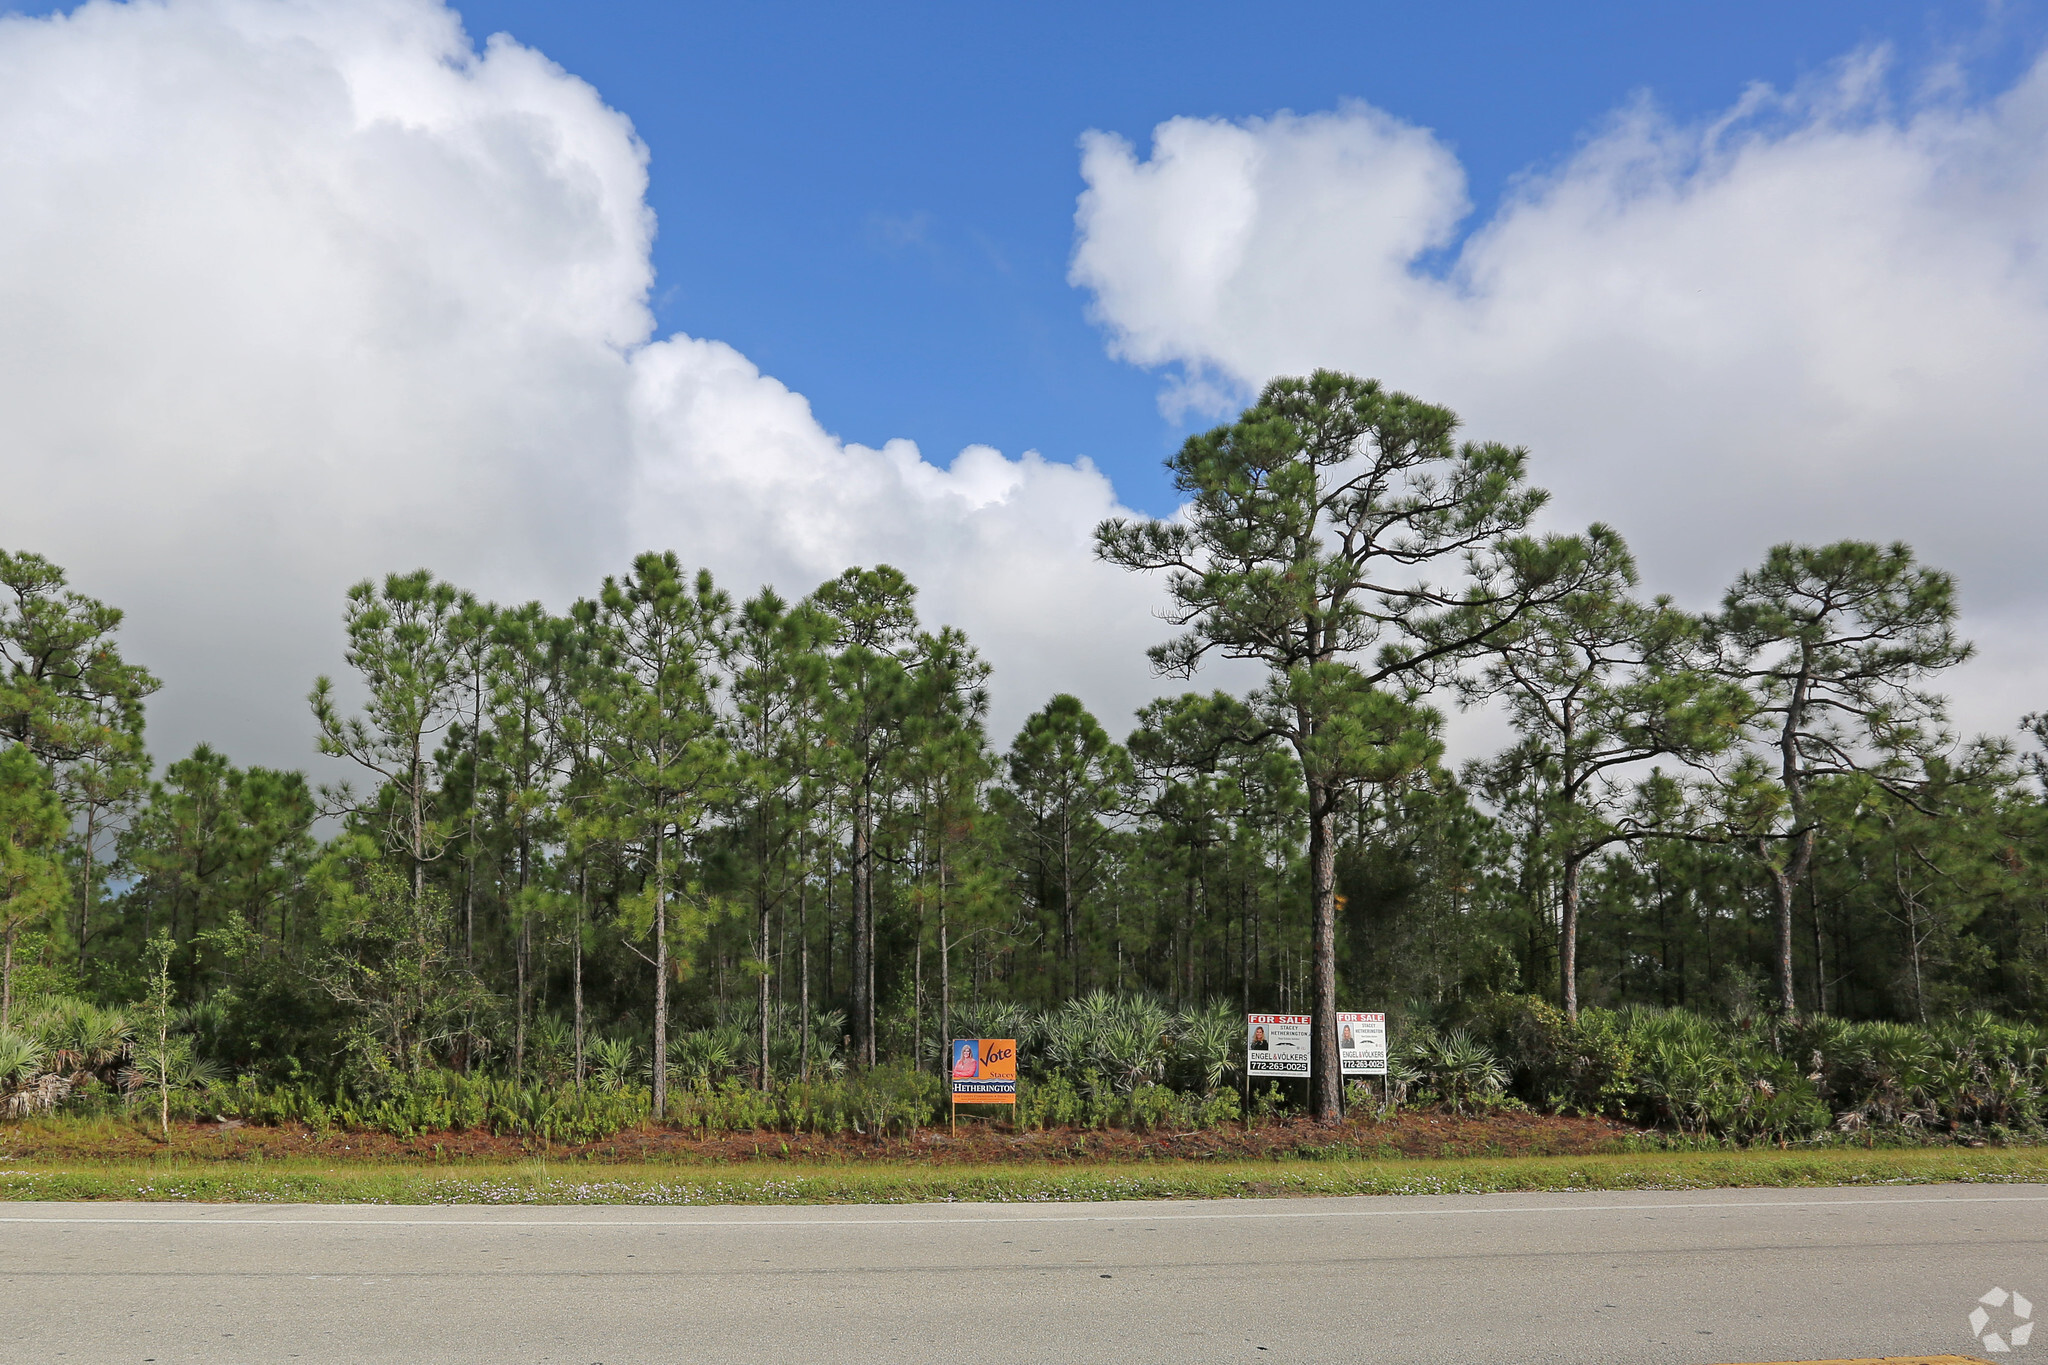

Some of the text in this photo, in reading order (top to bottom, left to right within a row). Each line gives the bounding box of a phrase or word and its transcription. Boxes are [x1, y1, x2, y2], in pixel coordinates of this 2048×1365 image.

[1278, 1016, 1308, 1024] SALE
[980, 1042, 1012, 1067] Vote
[1252, 1062, 1307, 1070] 772-263-0025
[954, 1083, 1015, 1092] HETHERINGTON
